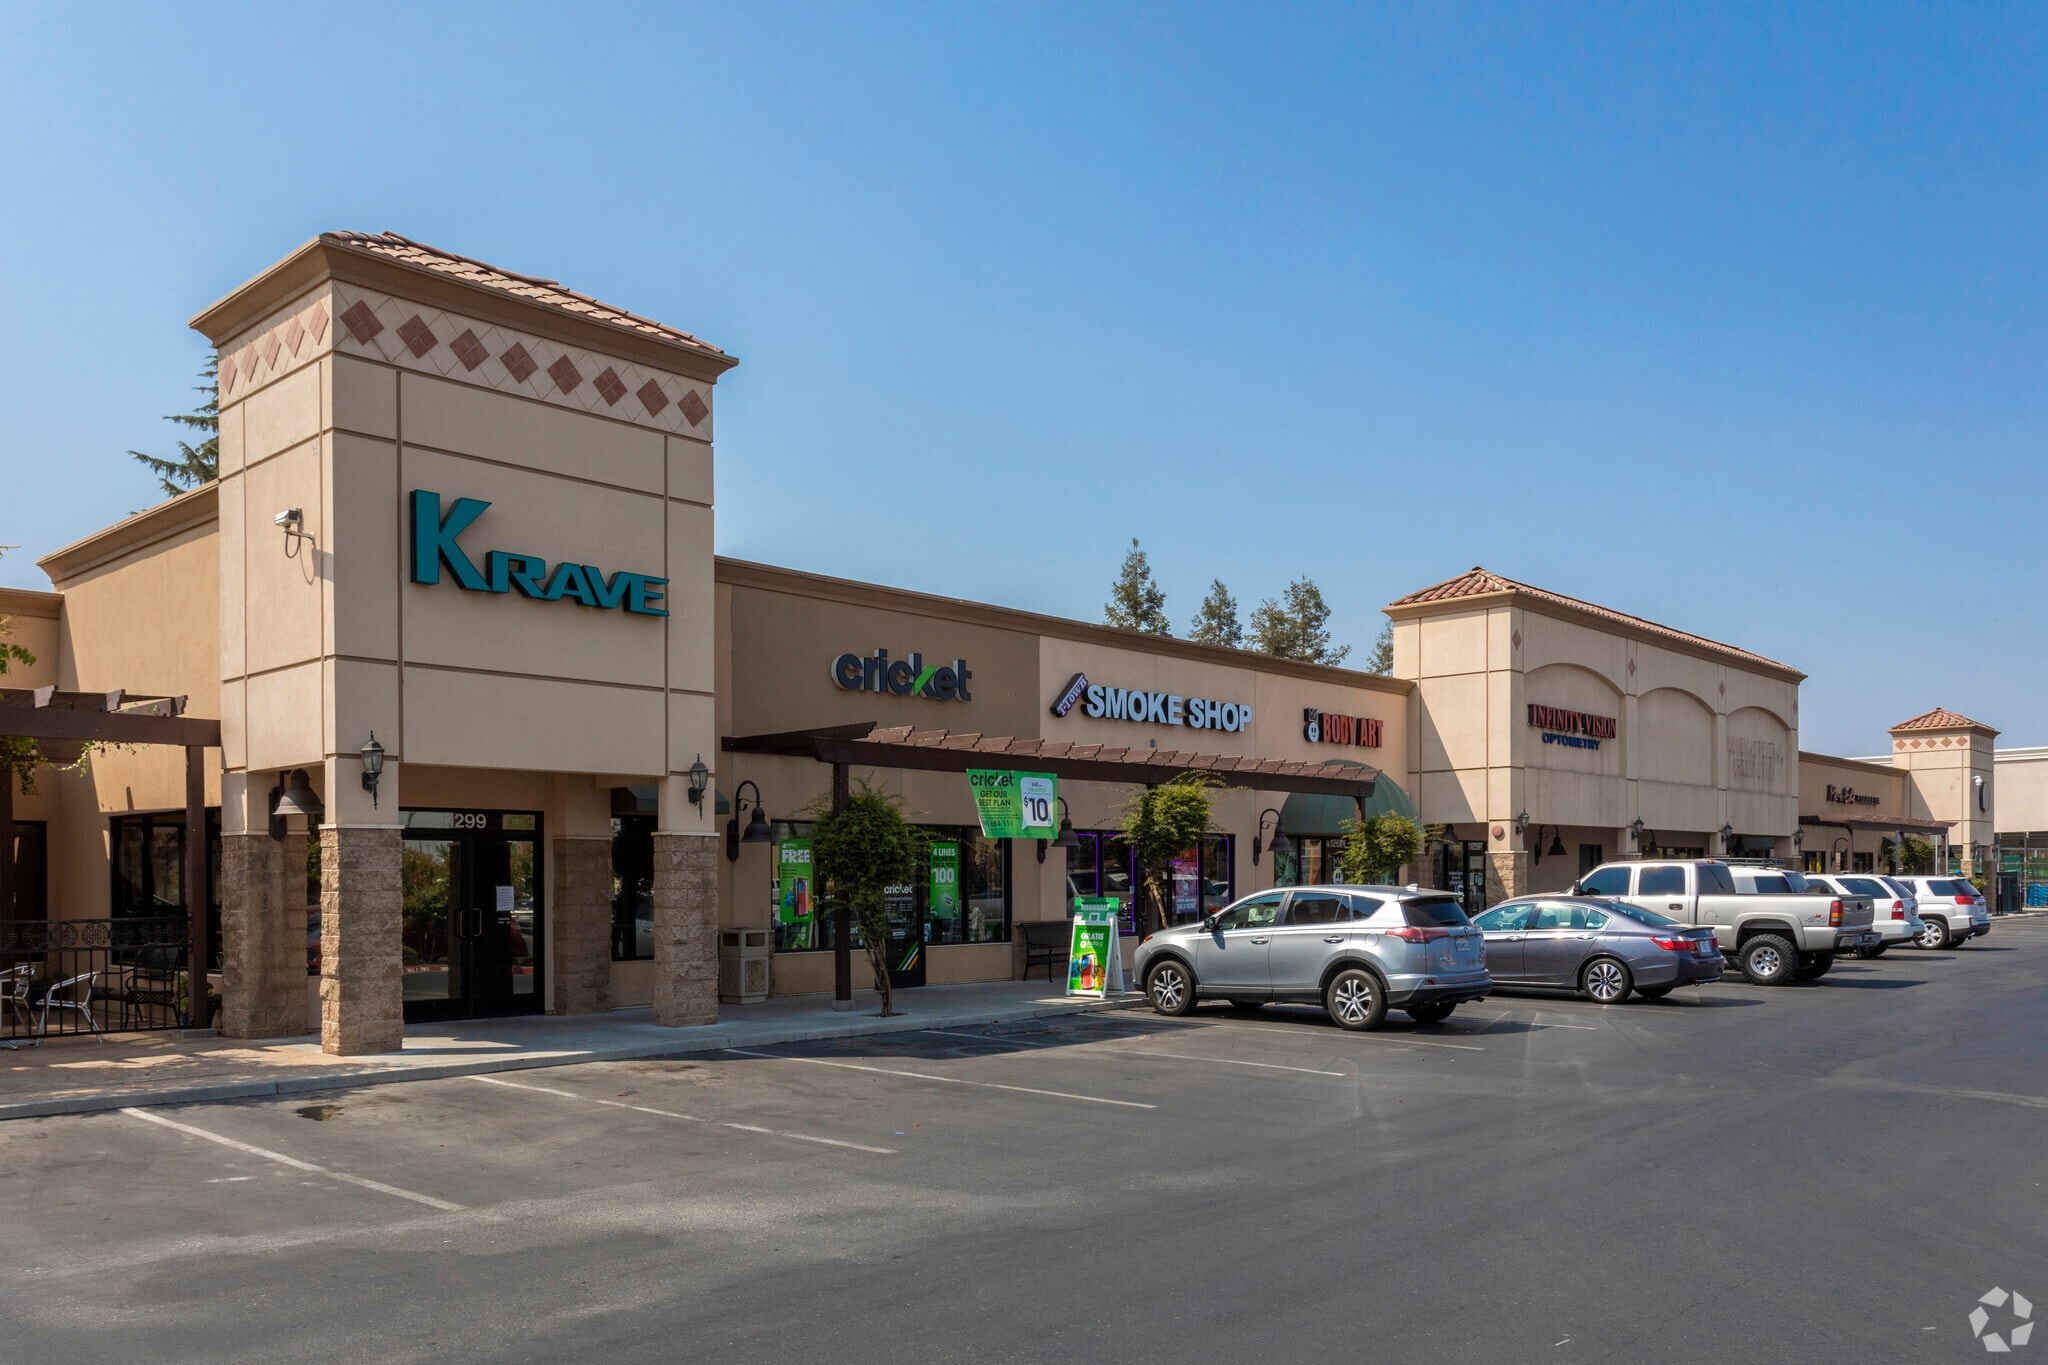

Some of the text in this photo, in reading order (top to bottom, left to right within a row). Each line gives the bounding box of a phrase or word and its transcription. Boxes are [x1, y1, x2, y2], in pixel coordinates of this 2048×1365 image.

[409, 489, 670, 617] KRAVE
[831, 648, 973, 702] cricket
[1083, 684, 1254, 733] SMOKE SHOP
[1529, 703, 1617, 739] INFINITY VISION
[1320, 712, 1384, 748] BODY ART
[1541, 732, 1601, 750] OPTOMETRY
[970, 772, 1014, 787] cricket
[980, 790, 993, 798] GET
[993, 799, 1011, 807] PLAN
[781, 849, 811, 863] FREE
[933, 848, 956, 857] 4 LINES
[883, 884, 913, 894] cricket
